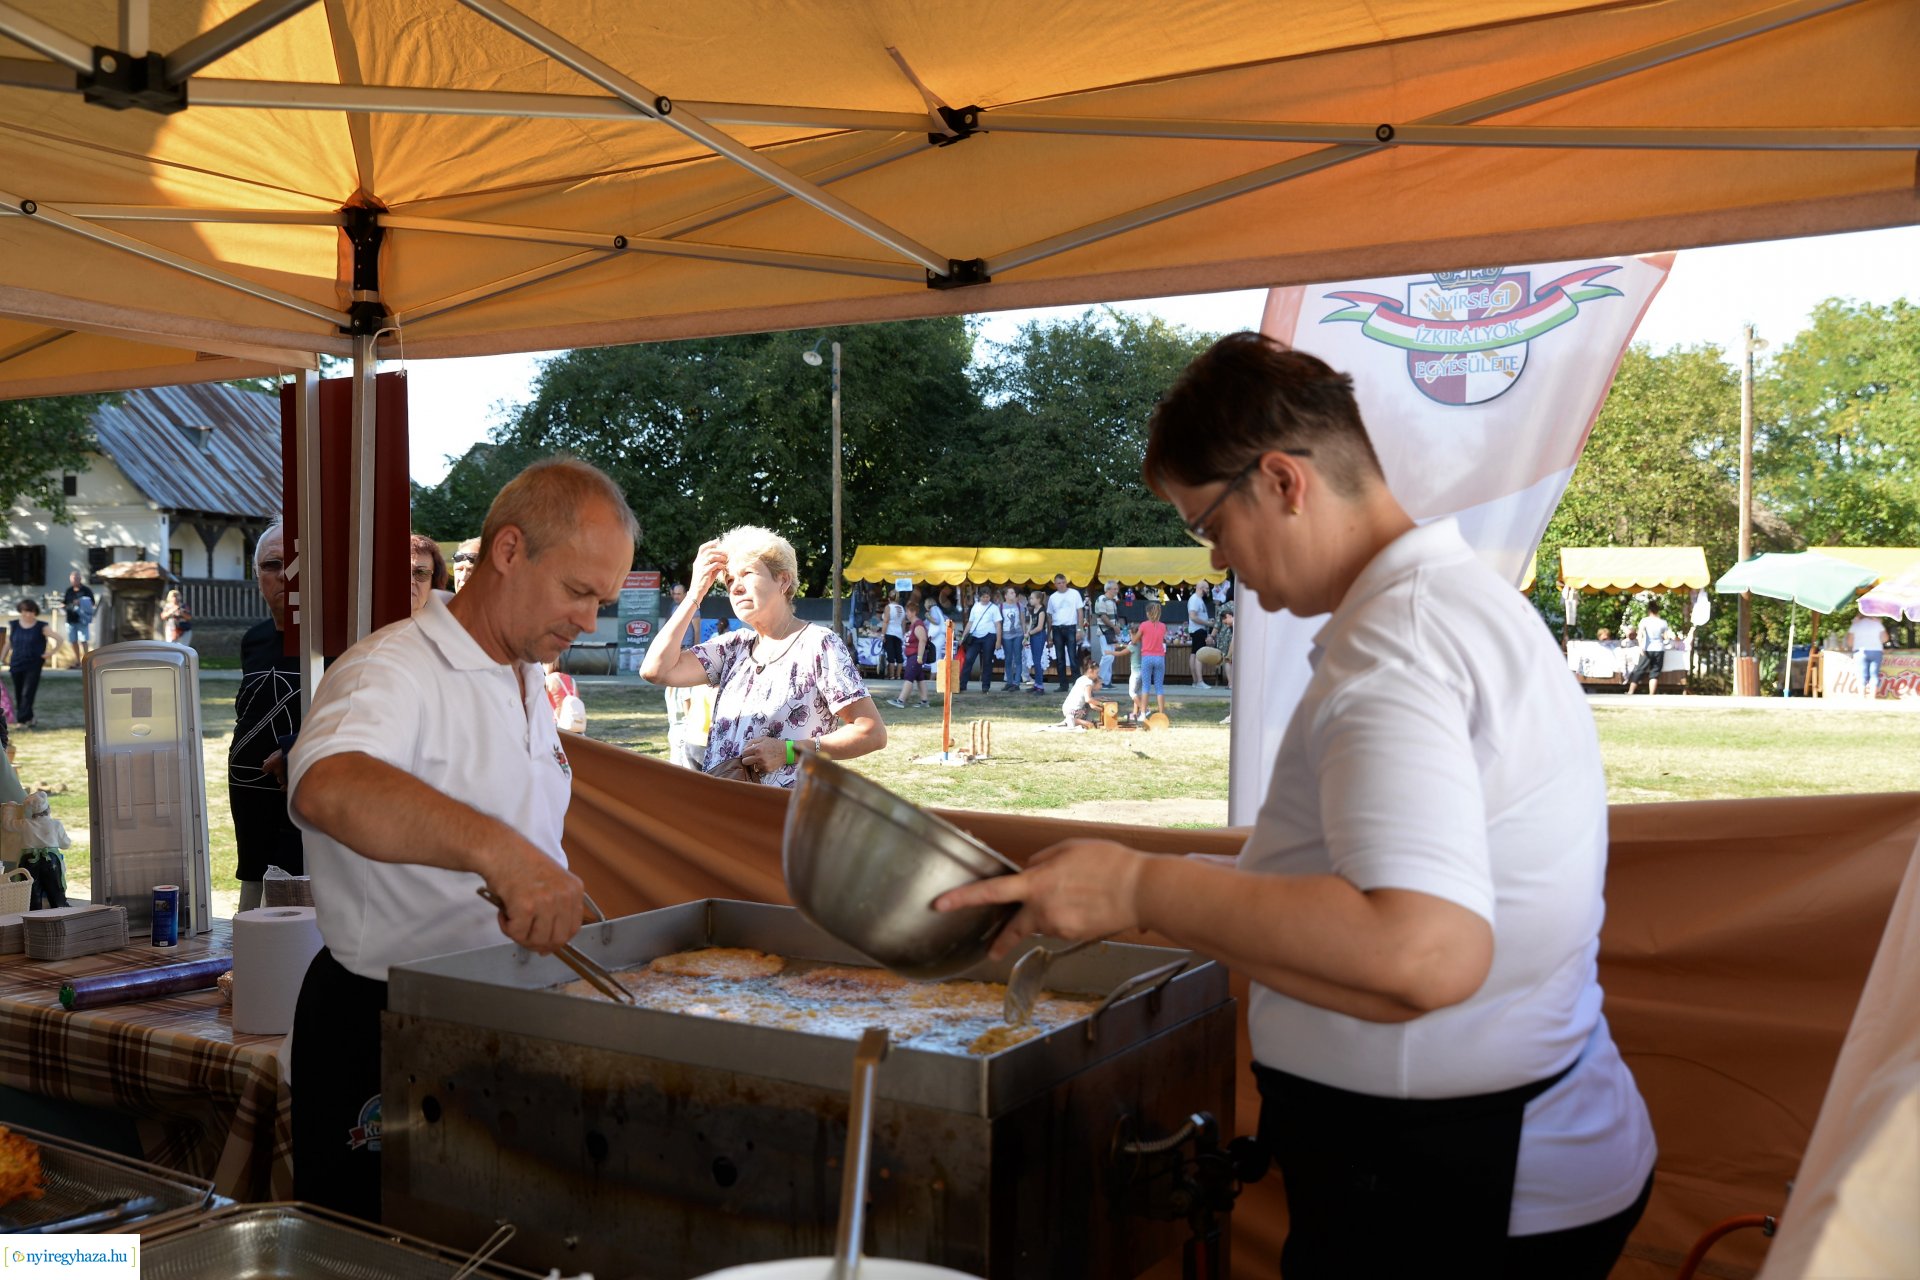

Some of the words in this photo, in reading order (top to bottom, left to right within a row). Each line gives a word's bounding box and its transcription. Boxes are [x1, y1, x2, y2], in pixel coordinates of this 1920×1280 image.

[1427, 288, 1510, 312] NYÍRSÉGI
[1414, 319, 1522, 345] ÍZKIRÁLYOK
[1415, 354, 1520, 379] EGYESÜLETE
